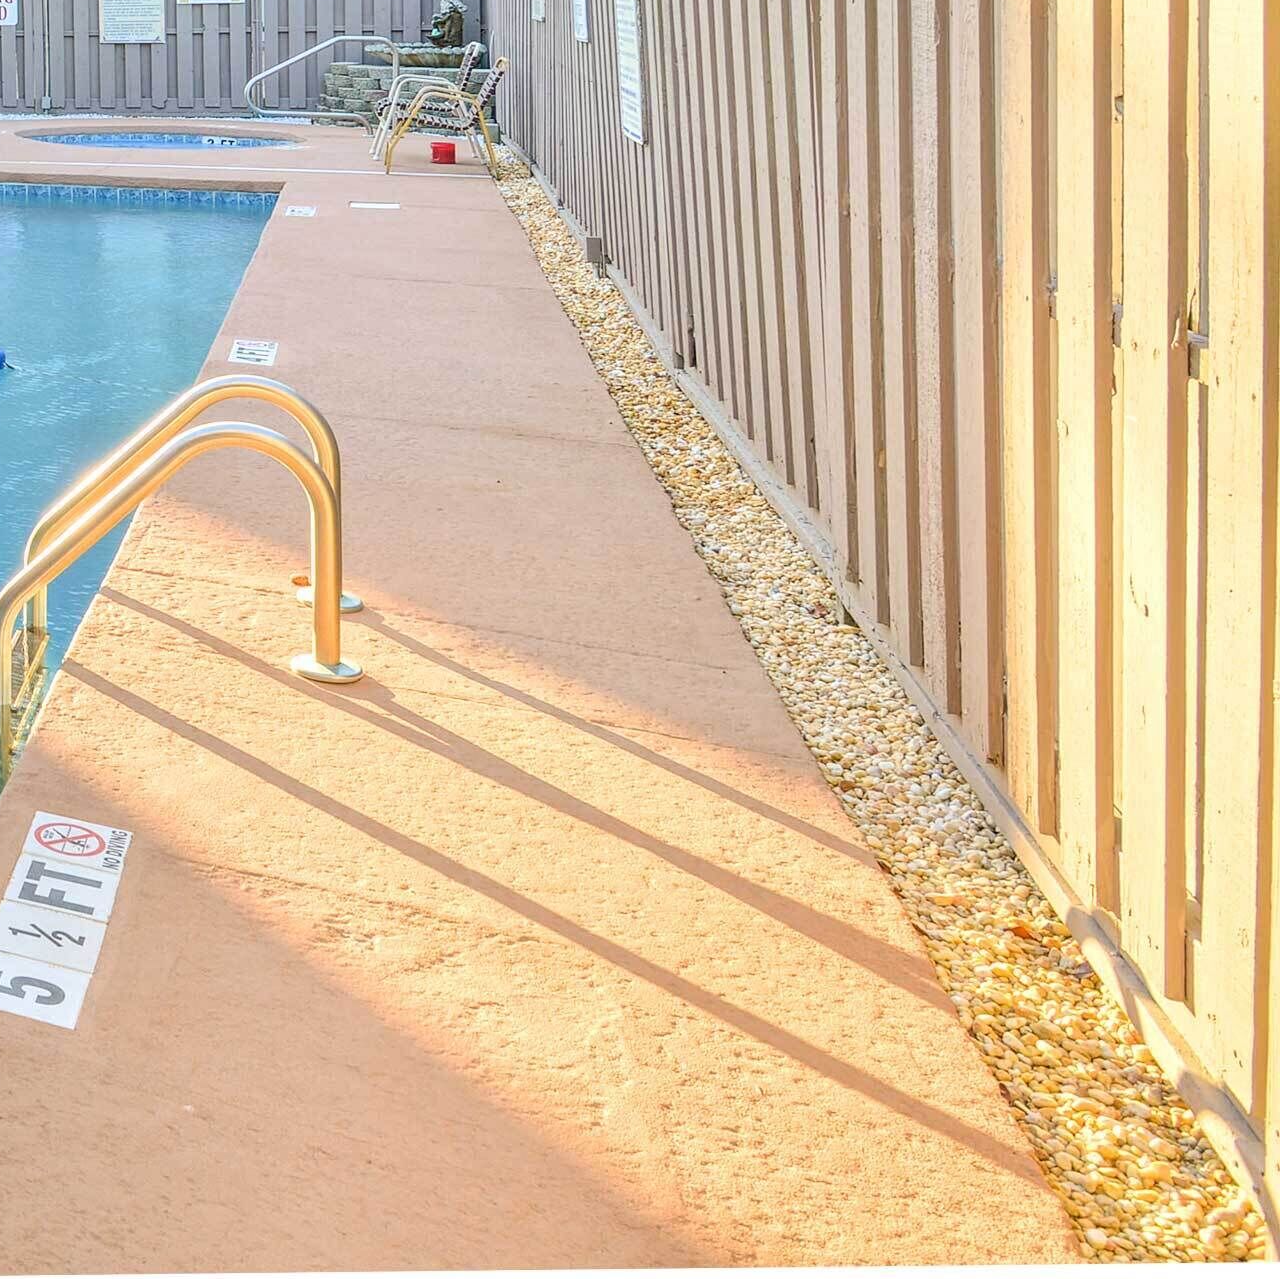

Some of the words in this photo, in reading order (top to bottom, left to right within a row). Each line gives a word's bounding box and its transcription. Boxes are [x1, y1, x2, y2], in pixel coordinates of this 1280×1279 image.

[106, 830, 128, 857] DIVING
[101, 857, 121, 871] NO
[18, 860, 104, 916] FT
